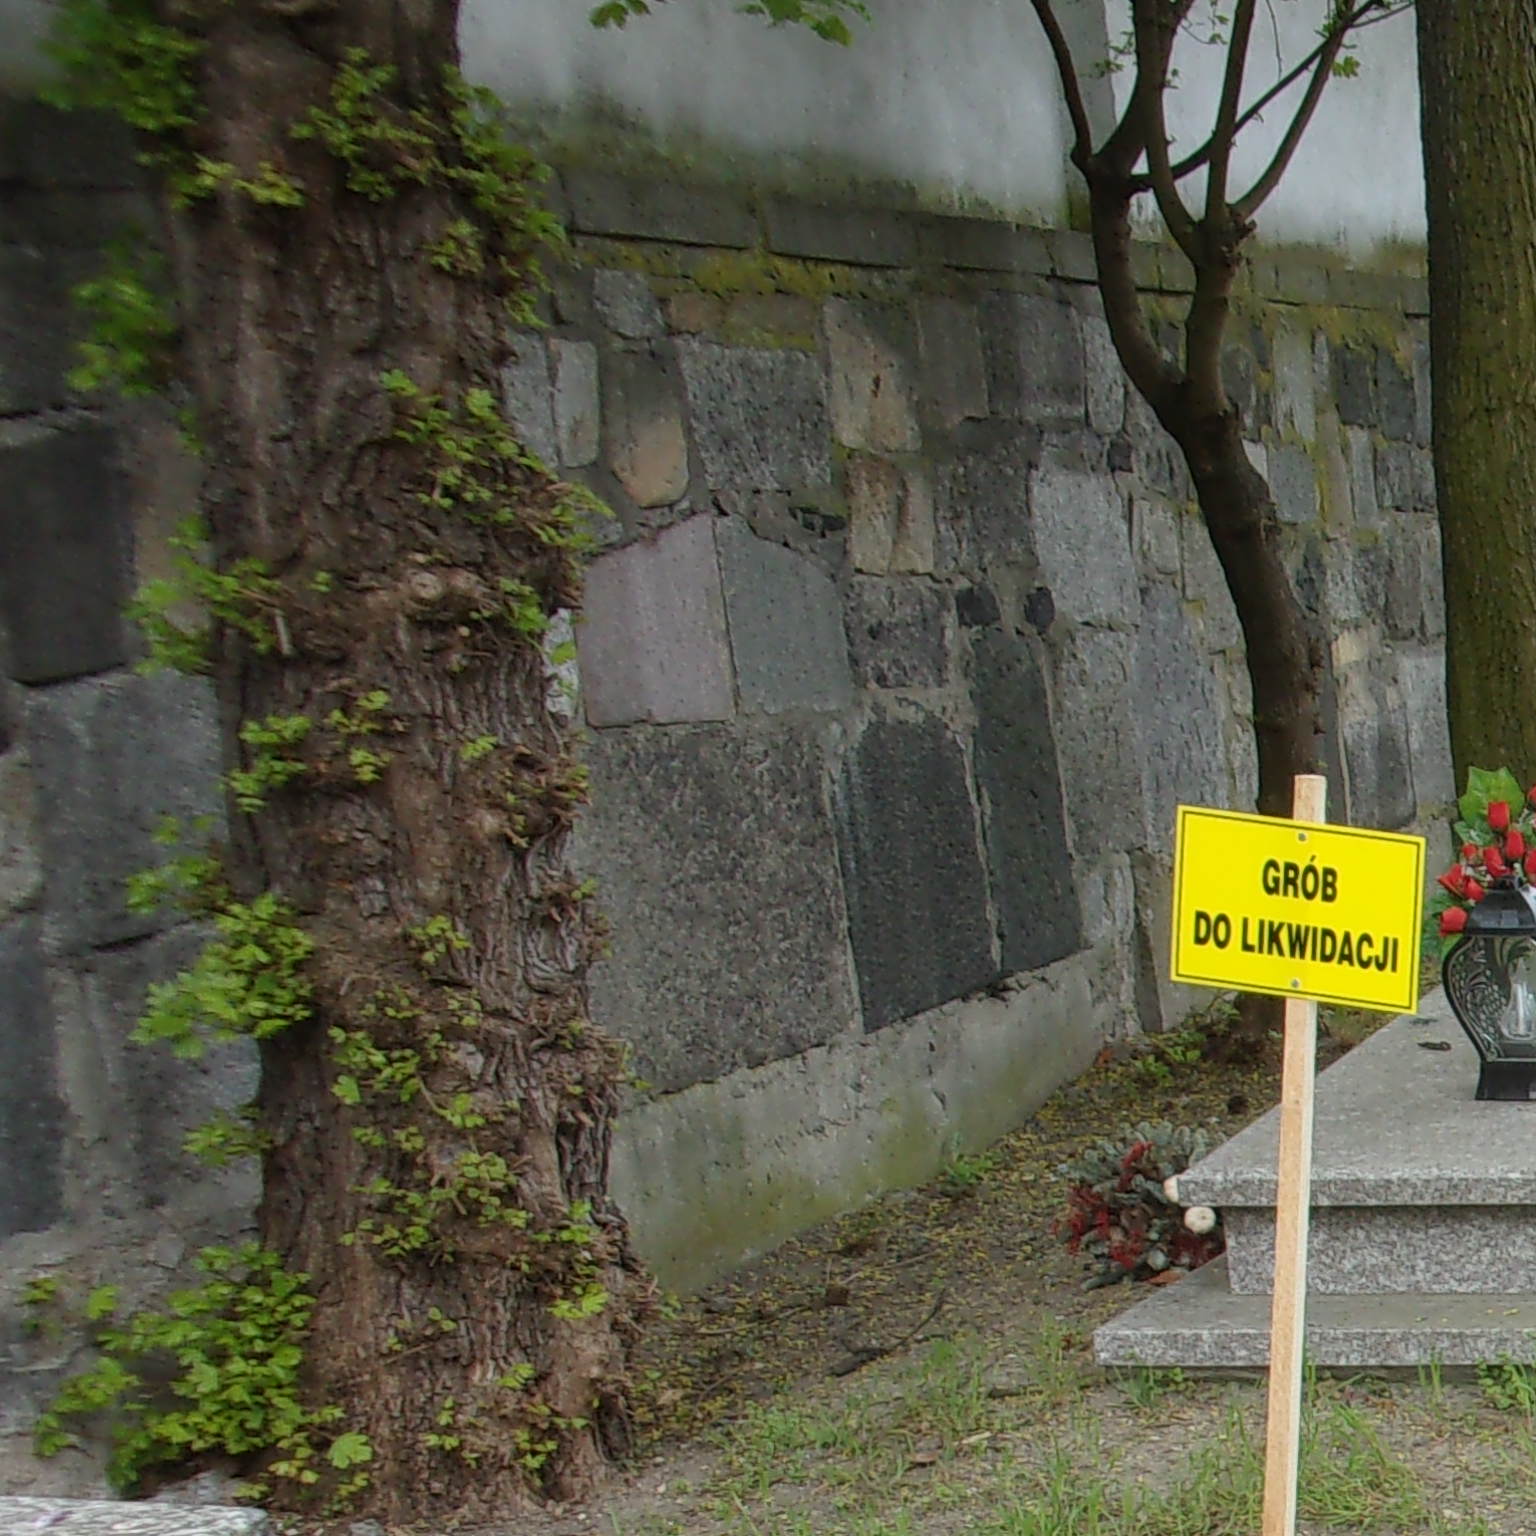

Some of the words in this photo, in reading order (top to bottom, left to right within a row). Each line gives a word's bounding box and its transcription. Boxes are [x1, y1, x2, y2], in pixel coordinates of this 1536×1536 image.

[1262, 853, 1337, 903] GRÓB
[1194, 911, 1231, 949] DO
[1241, 918, 1399, 973] LIKWIDACJI
